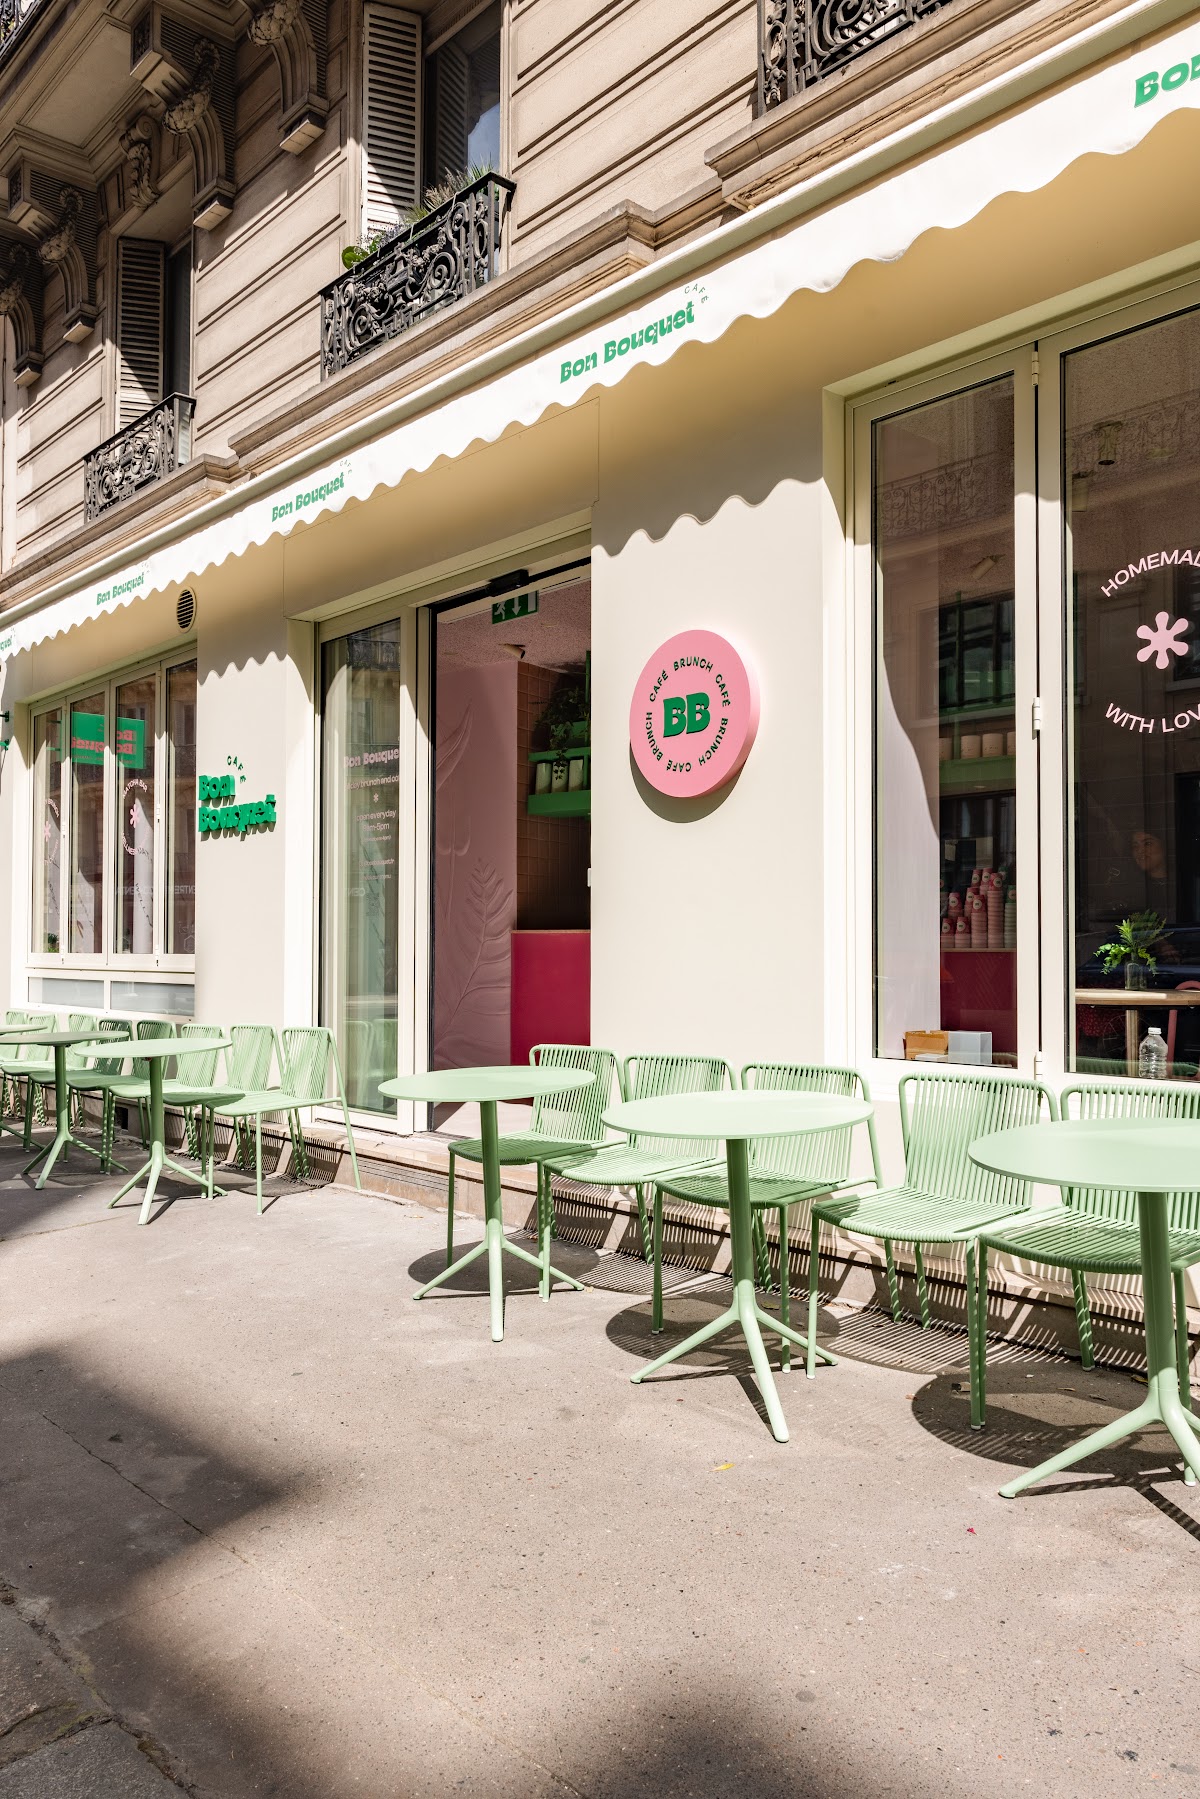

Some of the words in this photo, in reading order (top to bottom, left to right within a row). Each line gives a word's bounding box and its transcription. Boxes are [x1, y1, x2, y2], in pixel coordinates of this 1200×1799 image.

[560, 351, 598, 385] Bon
[603, 300, 695, 364] Bouquet
[271, 501, 293, 523] Bon
[295, 471, 345, 511] Bouquet
[96, 590, 111, 606] Bon
[112, 572, 145, 599] Bouquet
[673, 655, 714, 673] BRUNCH
[649, 669, 669, 703] CAFÉ
[715, 673, 731, 708] CAFÉ
[662, 691, 711, 739] BB
[1105, 702, 1155, 734] WITH
[645, 711, 664, 762] BRUNCH
[698, 717, 729, 766] BRUNCH
[362, 748, 399, 765] Bouque
[666, 759, 692, 773] CAFÉ
[198, 774, 236, 802] Bon
[198, 794, 277, 833] Bouquet
